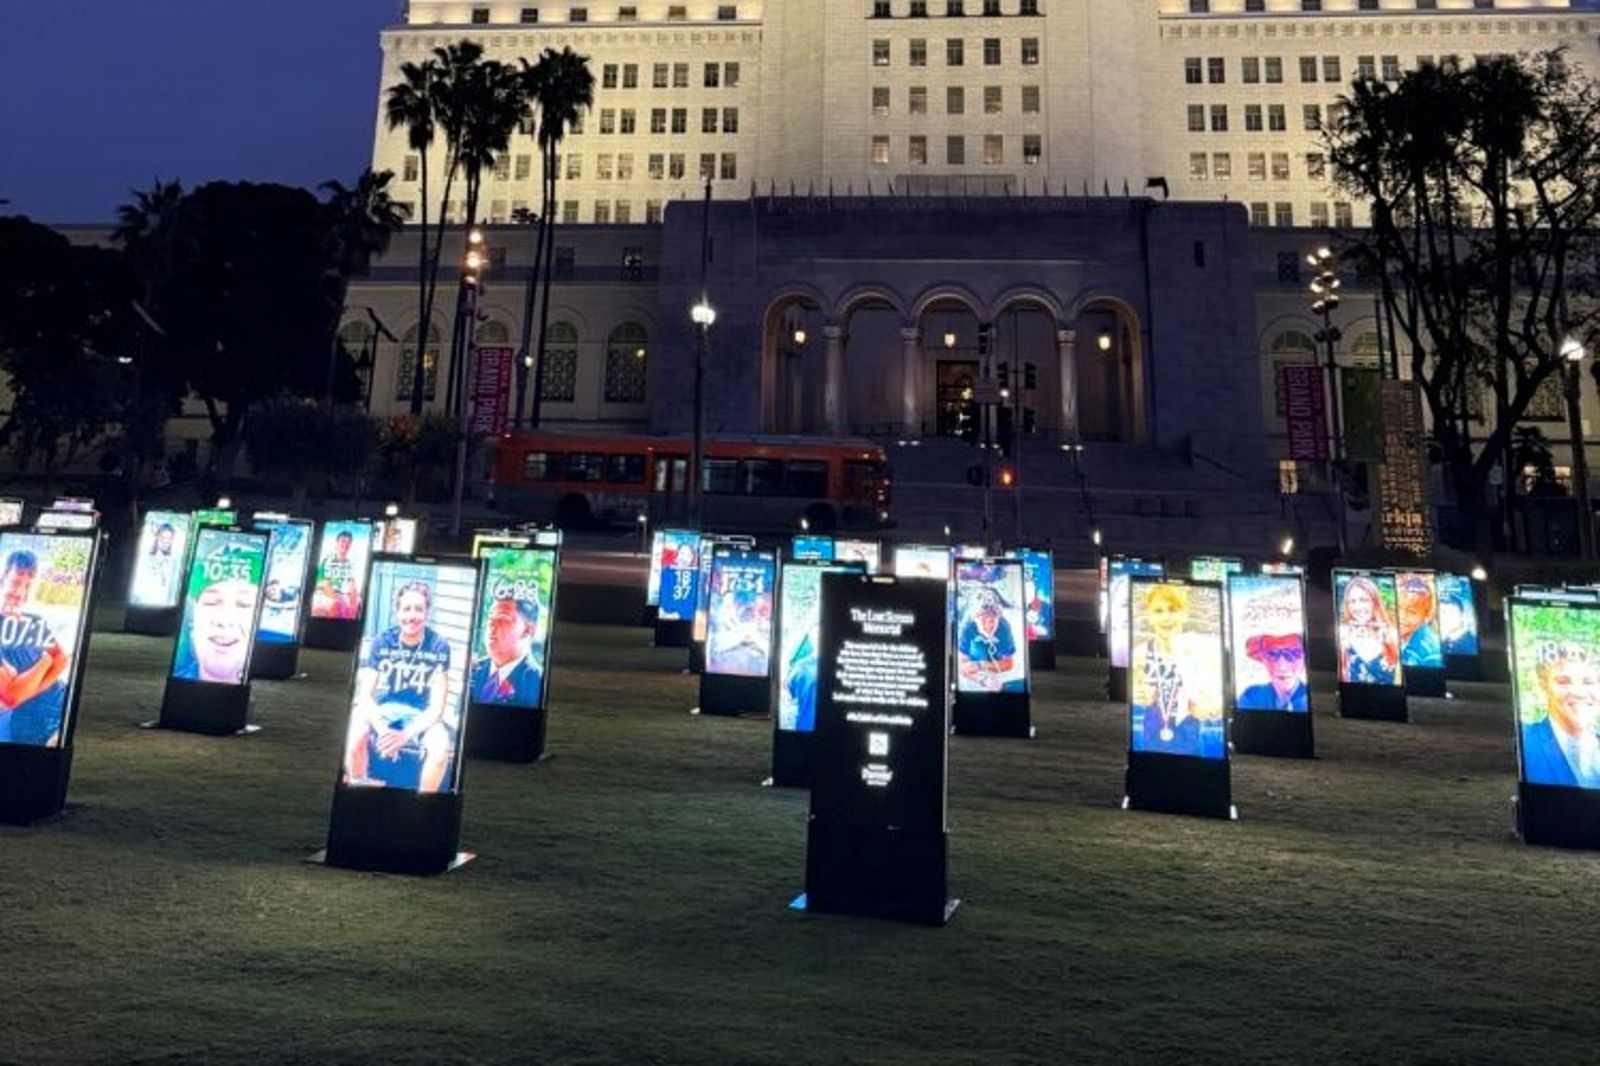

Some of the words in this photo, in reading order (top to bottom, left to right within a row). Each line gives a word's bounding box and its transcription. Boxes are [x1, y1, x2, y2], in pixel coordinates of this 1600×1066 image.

[1289, 367, 1312, 417] GRAND
[475, 398, 498, 434] PARK
[1292, 420, 1316, 458] PARK
[673, 585, 691, 600] 37
